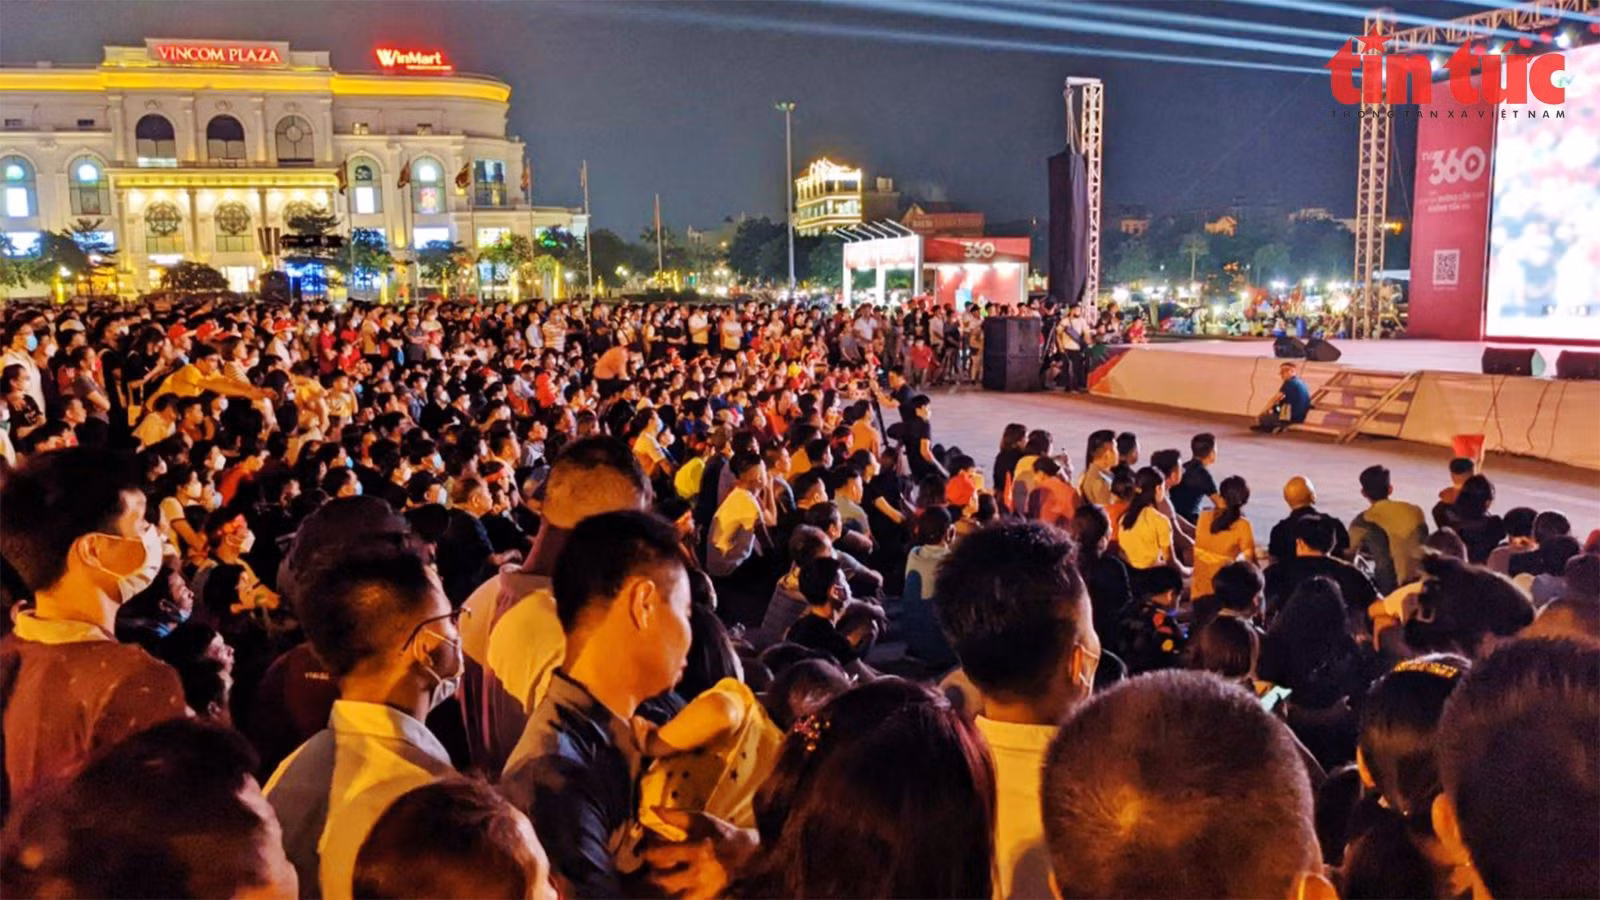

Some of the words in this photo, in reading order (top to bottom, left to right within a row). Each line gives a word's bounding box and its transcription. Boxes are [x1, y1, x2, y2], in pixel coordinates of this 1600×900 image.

[157, 46, 225, 61] VINCOM
[228, 47, 280, 62] PLAZA
[376, 48, 442, 67] WinMart
[1428, 146, 1486, 186] 360
[964, 242, 996, 258] 360
